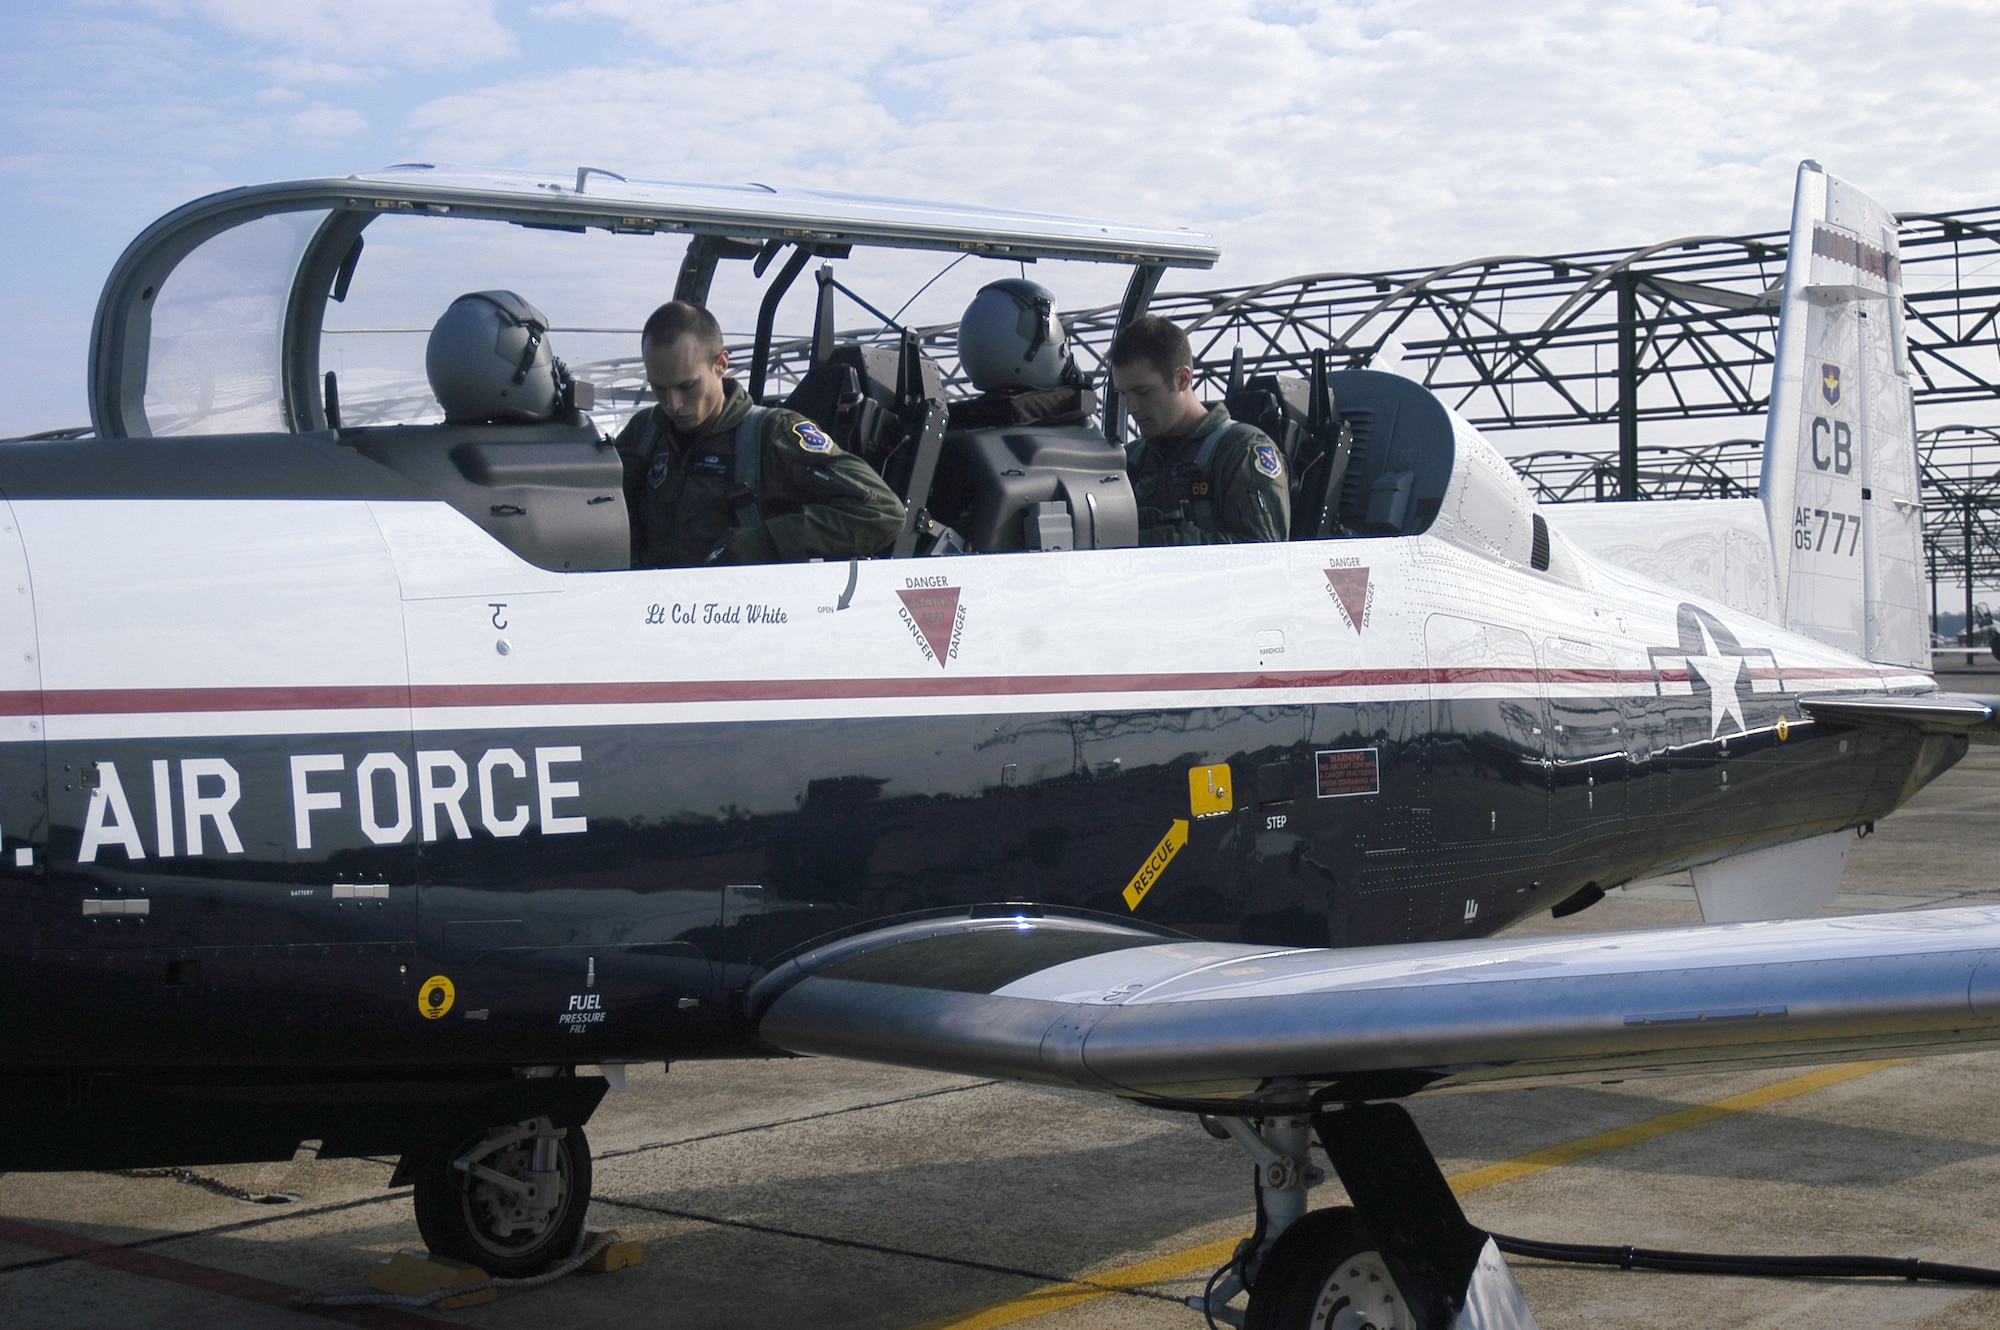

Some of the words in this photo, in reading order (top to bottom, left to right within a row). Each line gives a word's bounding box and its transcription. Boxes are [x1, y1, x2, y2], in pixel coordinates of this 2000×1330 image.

[1811, 416, 1852, 475] CB
[1192, 481, 1209, 495] 69
[1795, 506, 1811, 527] AF
[1795, 529, 1812, 551] 05
[1814, 508, 1861, 557] 777
[1329, 557, 1361, 568] DANGER
[905, 576, 949, 588] DANGER
[645, 603, 665, 624] Lt
[671, 603, 697, 624] Col
[703, 603, 741, 624] Todd
[746, 604, 789, 624] White
[817, 606, 834, 614] OPEN
[1325, 583, 1352, 630] DANGER
[1363, 581, 1375, 628] DANGER
[898, 607, 934, 661] DANGER
[949, 604, 967, 660] DANGER
[78, 759, 244, 863] AIR
[290, 746, 587, 849] FORCE
[1266, 815, 1287, 829] STEP
[1133, 838, 1175, 895] RESCUE
[569, 994, 601, 1011] FUEL
[559, 1012, 606, 1024] PRESSURE
[569, 1024, 587, 1034] FILL
